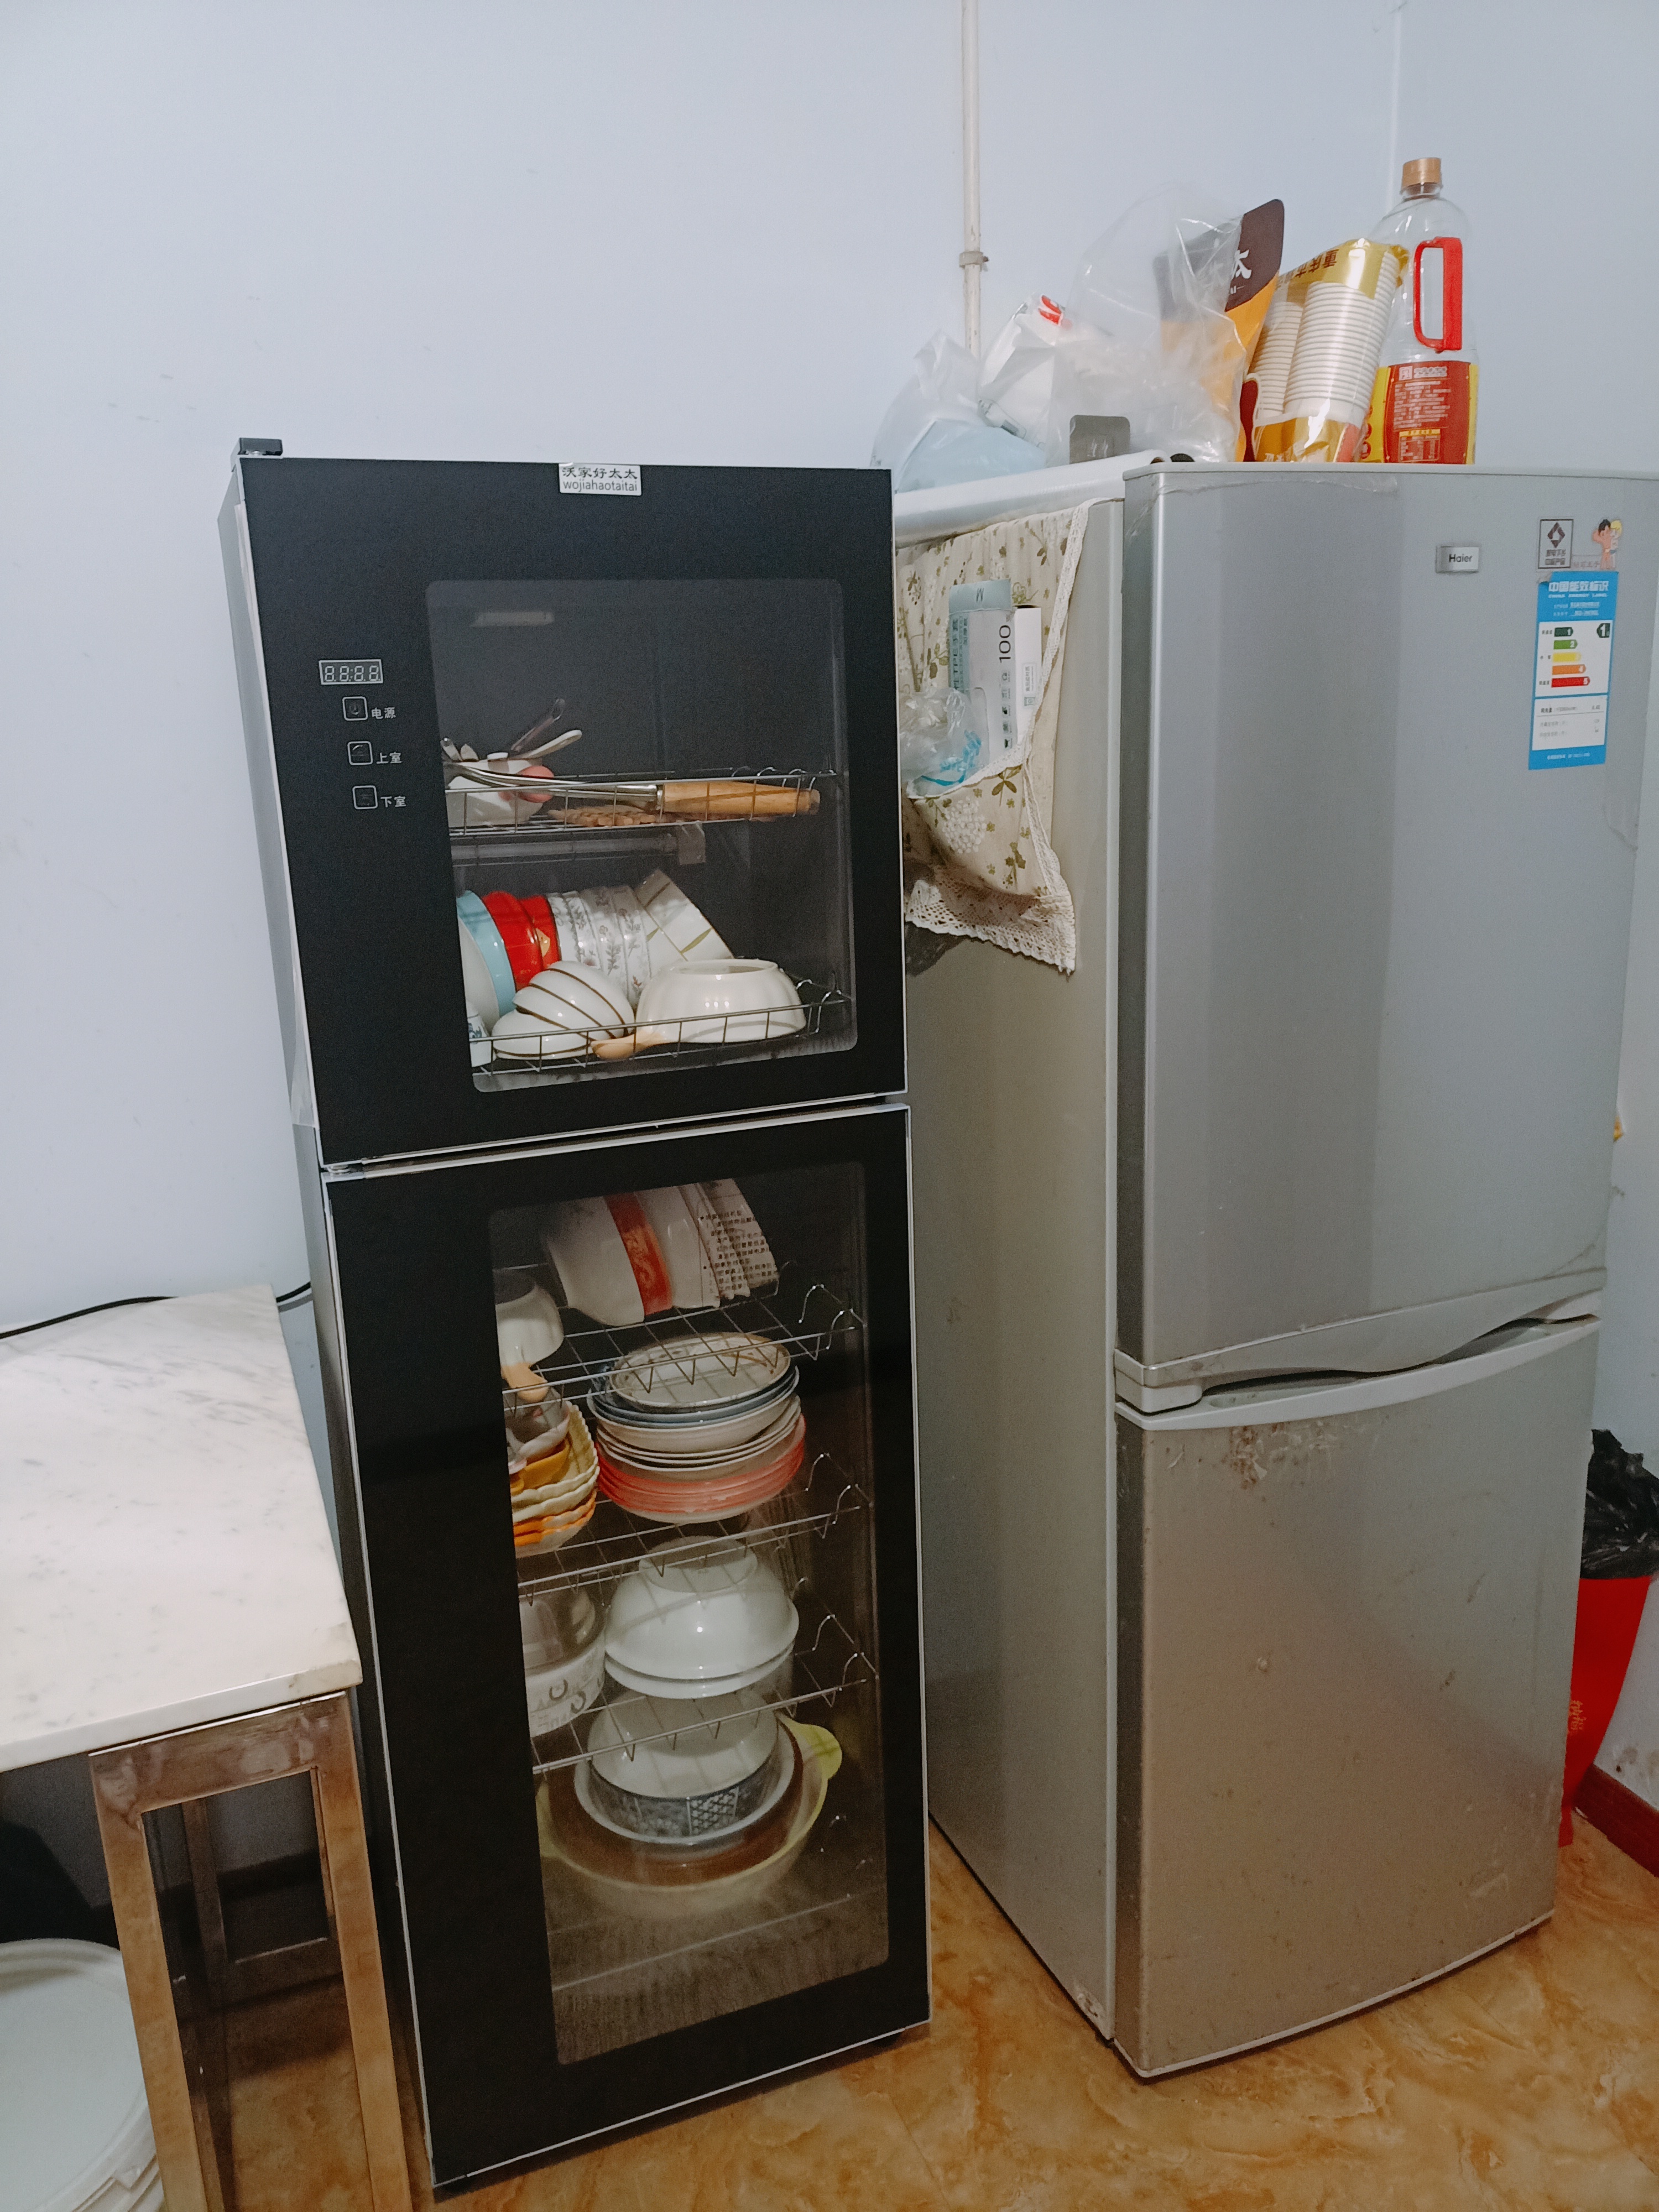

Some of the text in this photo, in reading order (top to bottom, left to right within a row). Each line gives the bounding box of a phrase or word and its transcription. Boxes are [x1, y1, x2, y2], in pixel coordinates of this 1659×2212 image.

[562, 467, 638, 479] 沃家好太太
[563, 478, 638, 492] wojiahaotaitai
[1448, 554, 1473, 562] Haier
[999, 625, 1011, 663] 100
[371, 707, 397, 719] 电源
[376, 752, 403, 764] 上室
[380, 795, 406, 808] 下室
